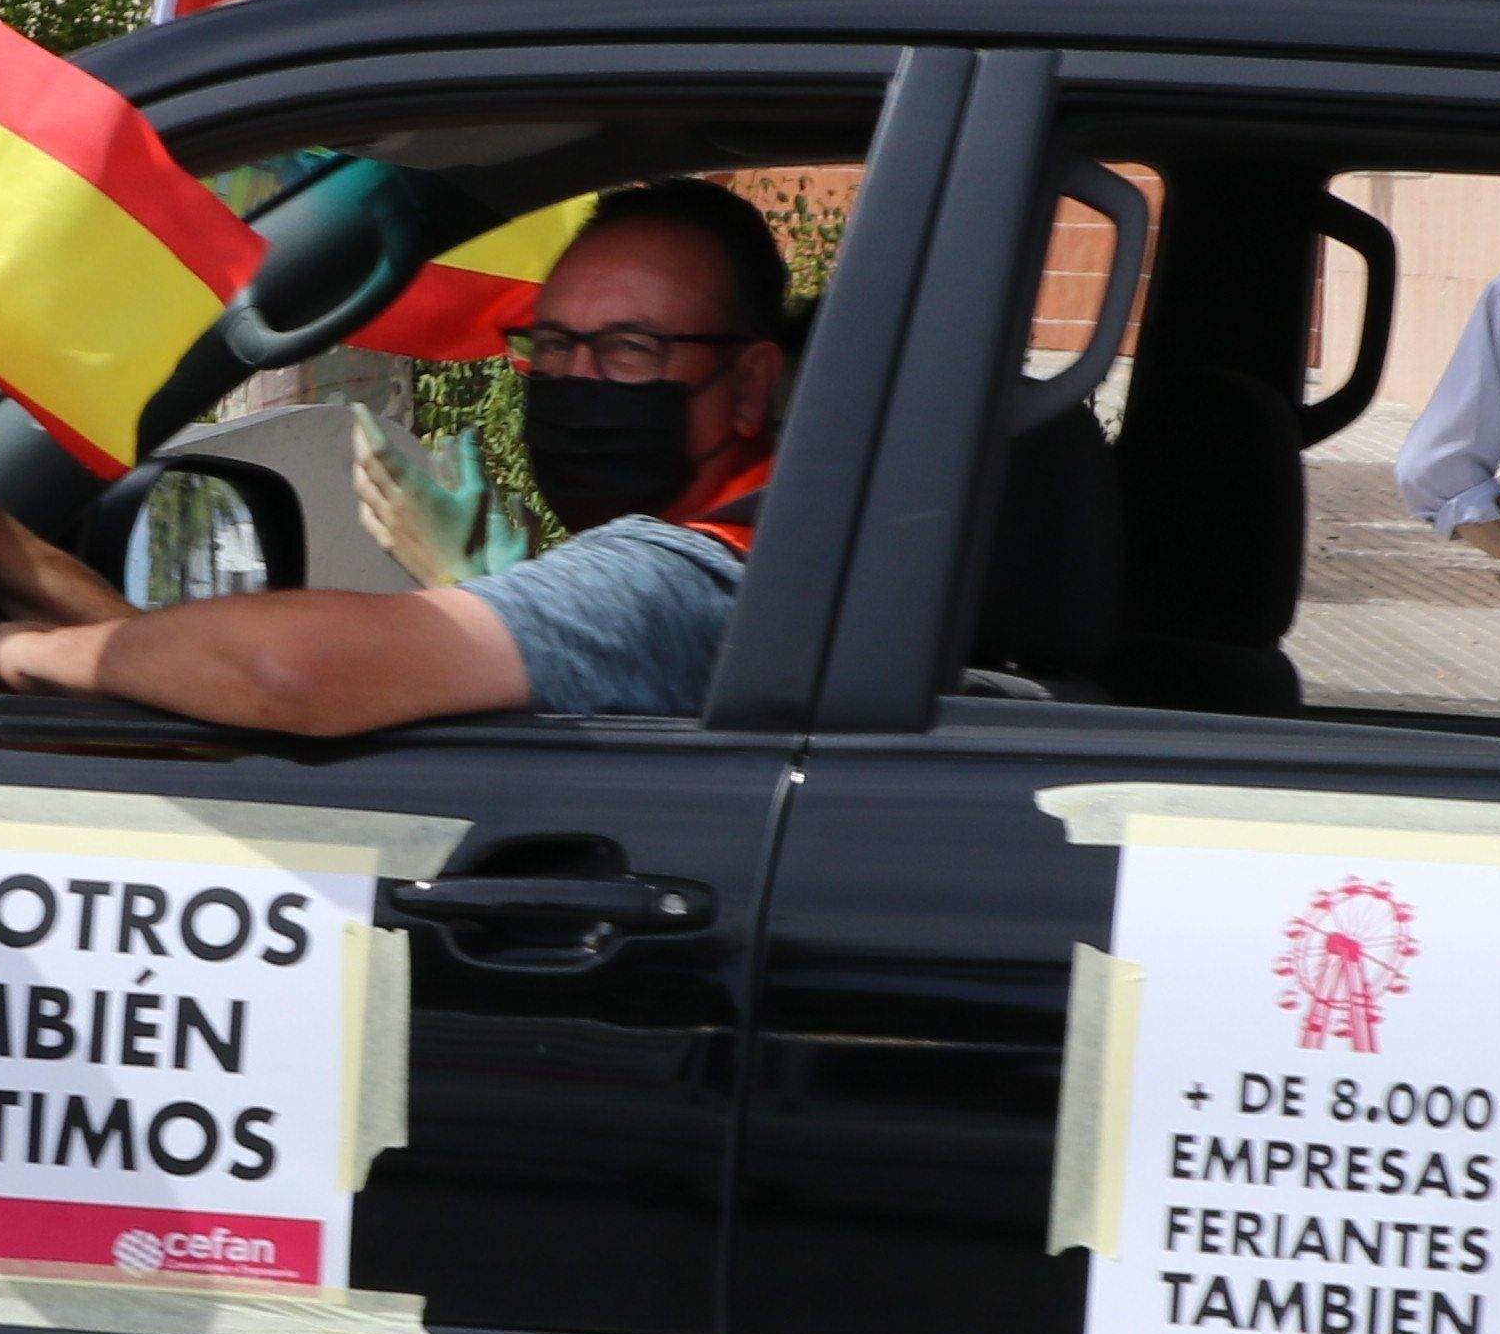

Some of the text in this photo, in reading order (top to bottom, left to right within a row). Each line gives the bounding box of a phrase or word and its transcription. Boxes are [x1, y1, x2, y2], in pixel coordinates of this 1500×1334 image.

[1238, 1071, 1306, 1118] DE
[1328, 1077, 1498, 1131] 8.000
[1168, 1132, 1497, 1201] EMPRESAS
[163, 1228, 276, 1265] cefan
[1163, 1205, 1493, 1274] FERIANTES
